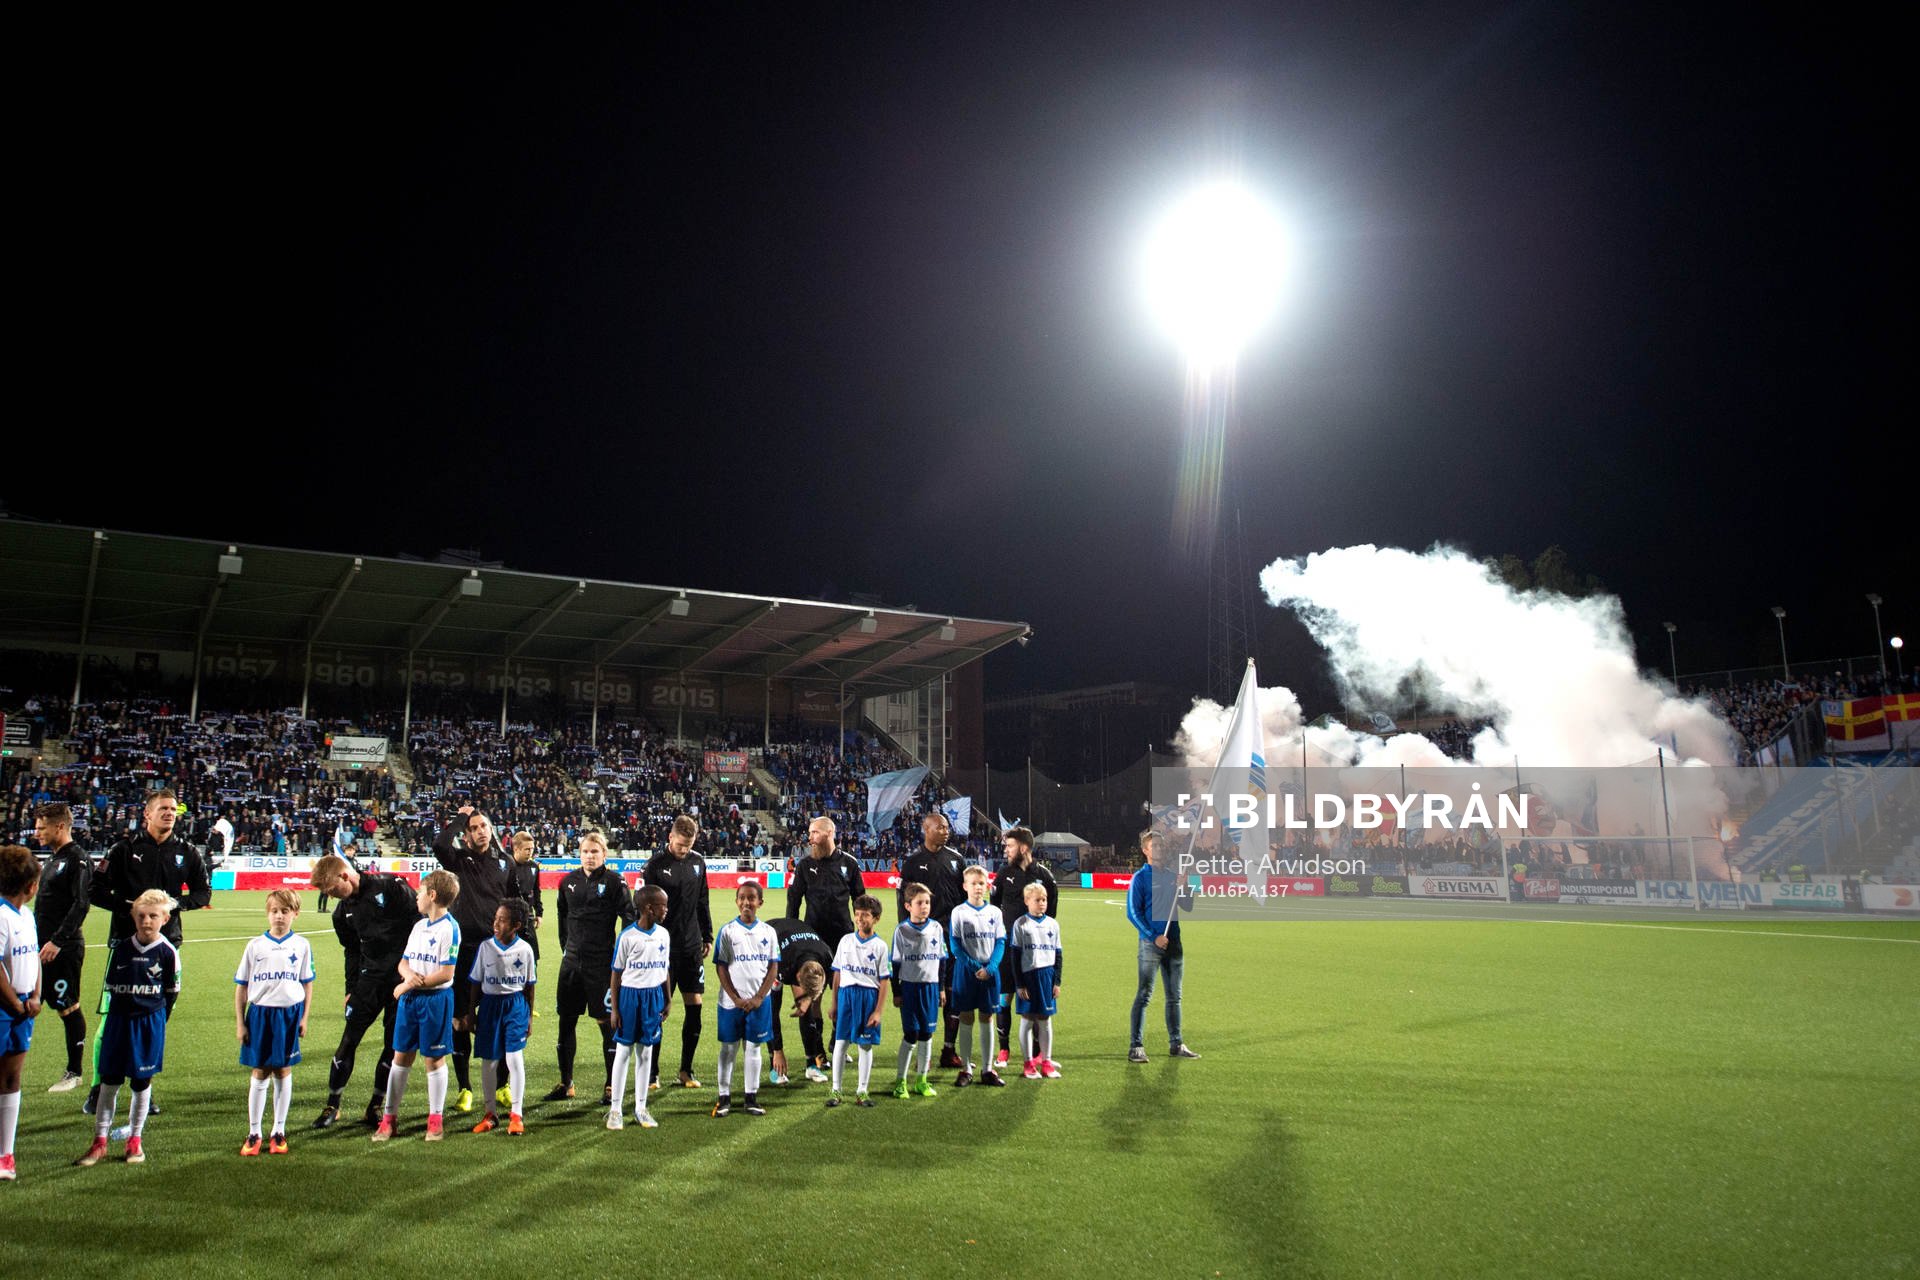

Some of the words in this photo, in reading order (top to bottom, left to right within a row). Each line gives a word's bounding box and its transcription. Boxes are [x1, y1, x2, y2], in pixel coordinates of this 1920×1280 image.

[571, 680, 632, 703] 1989
[652, 685, 715, 708] 2015
[624, 862, 645, 870] ATE
[705, 863, 729, 872] wegon
[1437, 880, 1496, 894] BYGMA
[1560, 885, 1636, 896] INDUSTRIPORTAR
[1645, 880, 1763, 903] HOLMEN
[1779, 883, 1838, 897] SEFAB
[904, 954, 941, 962] HOLMEN
[629, 961, 666, 970] HOLMEN
[842, 964, 876, 977] HOLMEN
[253, 970, 298, 982] HOLMEN
[54, 979, 68, 999] 9
